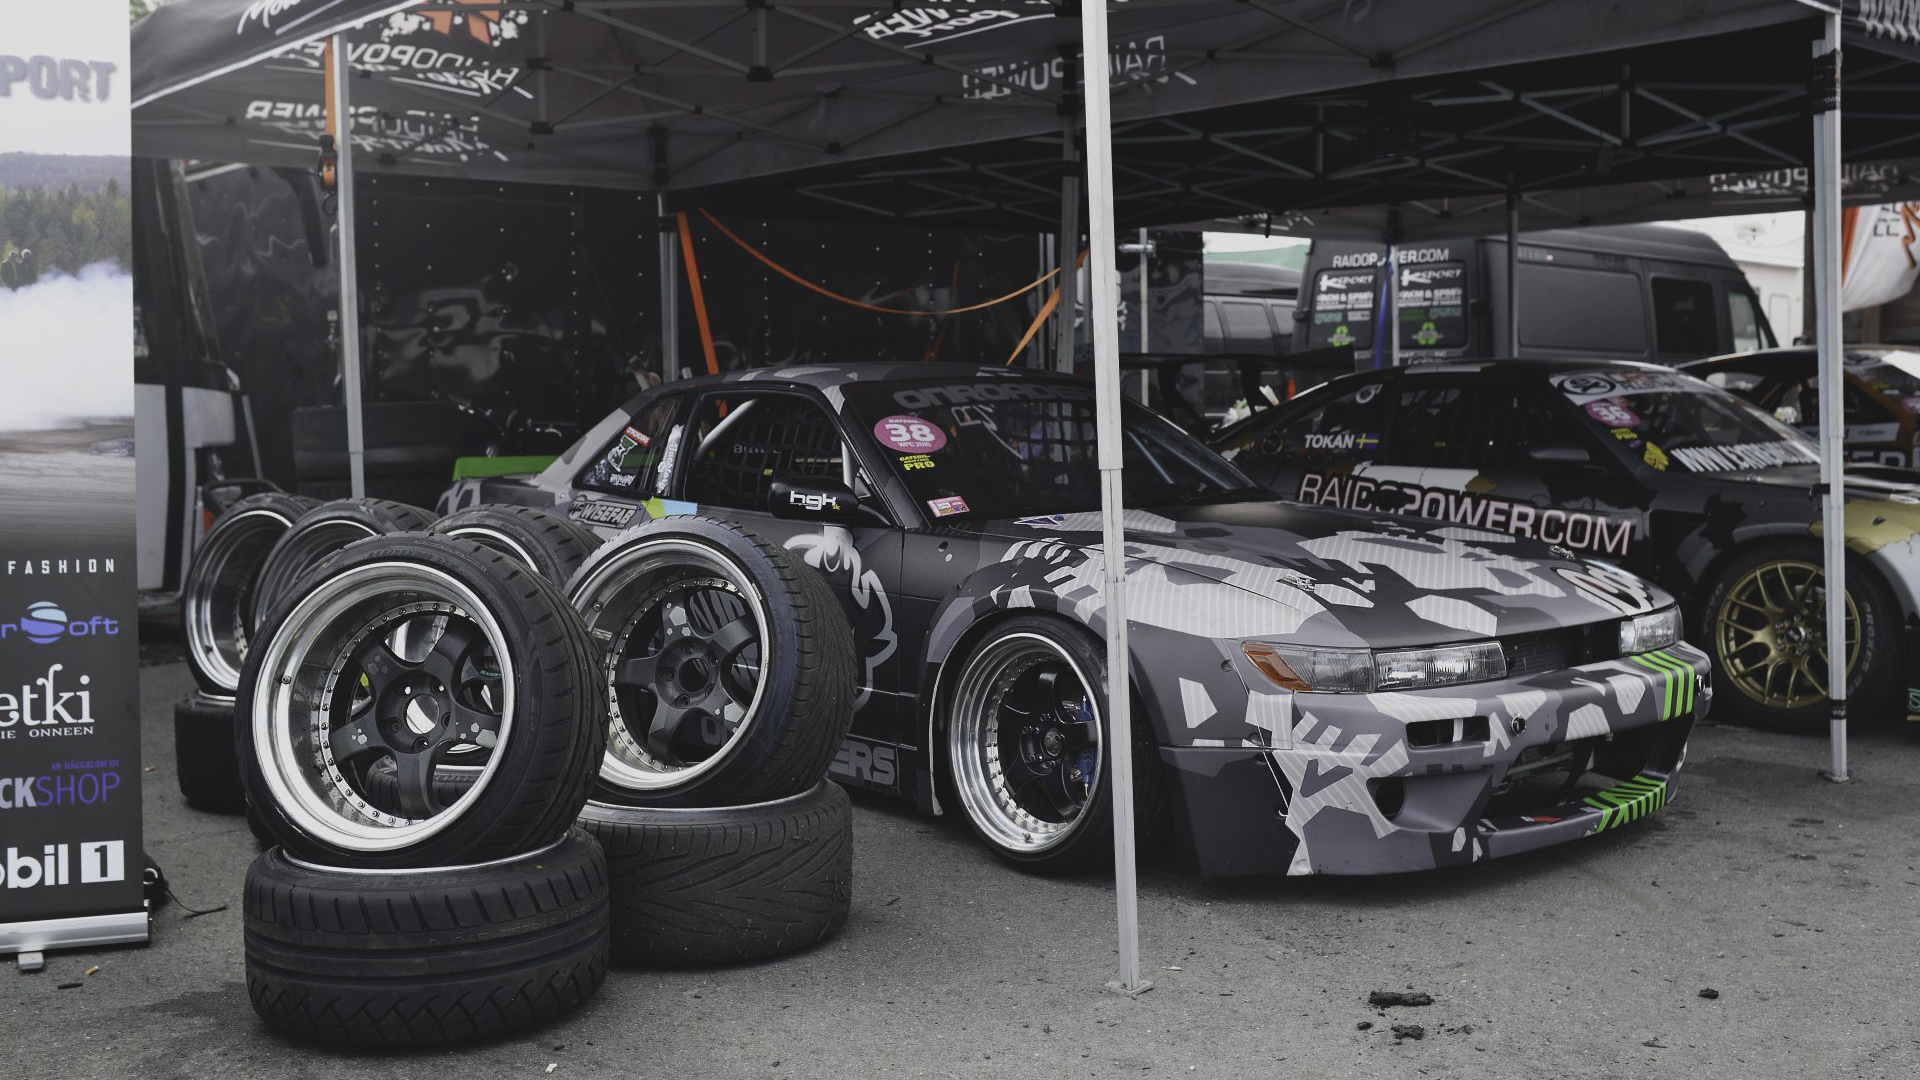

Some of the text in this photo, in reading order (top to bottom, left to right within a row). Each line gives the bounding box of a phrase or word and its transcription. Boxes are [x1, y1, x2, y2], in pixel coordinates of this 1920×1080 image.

[0, 55, 117, 102] PORT
[1592, 405, 1632, 421] 36
[884, 423, 935, 443] 38
[1304, 434, 1355, 449] TOKAN
[904, 461, 936, 471] PRO
[790, 490, 837, 511] hgk
[581, 502, 636, 526] WISEFAB
[7, 558, 115, 575] FASHION
[28, 726, 95, 738] ONNEEN
[0, 843, 70, 889] bil
